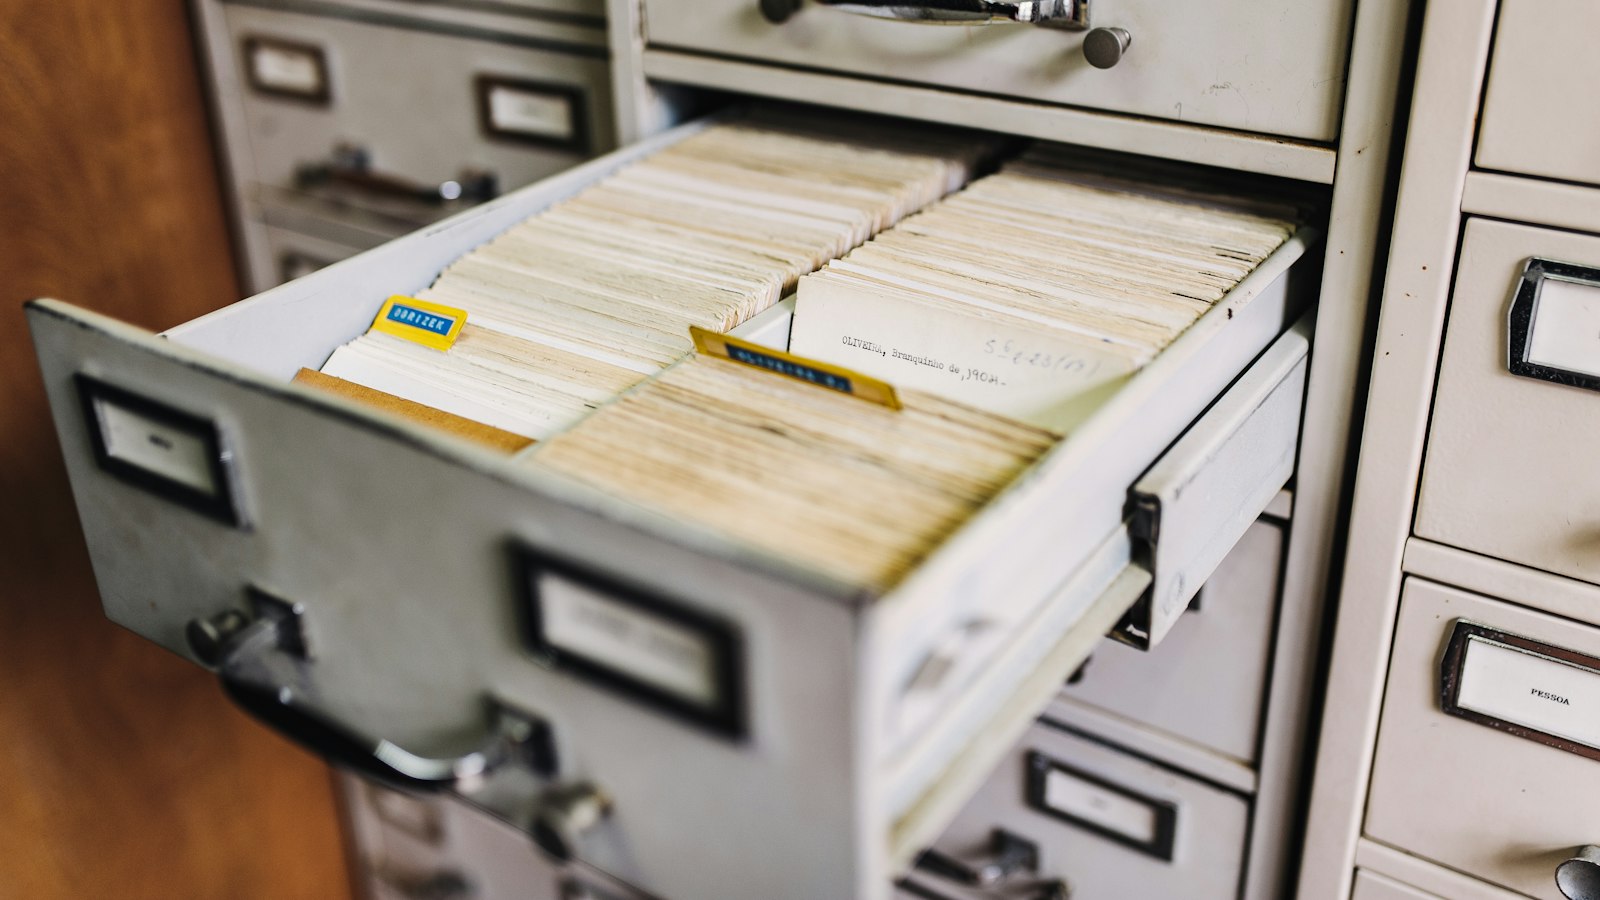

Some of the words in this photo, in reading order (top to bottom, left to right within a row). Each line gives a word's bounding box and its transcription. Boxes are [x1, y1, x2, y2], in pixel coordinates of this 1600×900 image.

[842, 335, 885, 357] OLIVEIRA,
[891, 348, 944, 370] Branquinho
[1530, 688, 1570, 705] PESSOA
